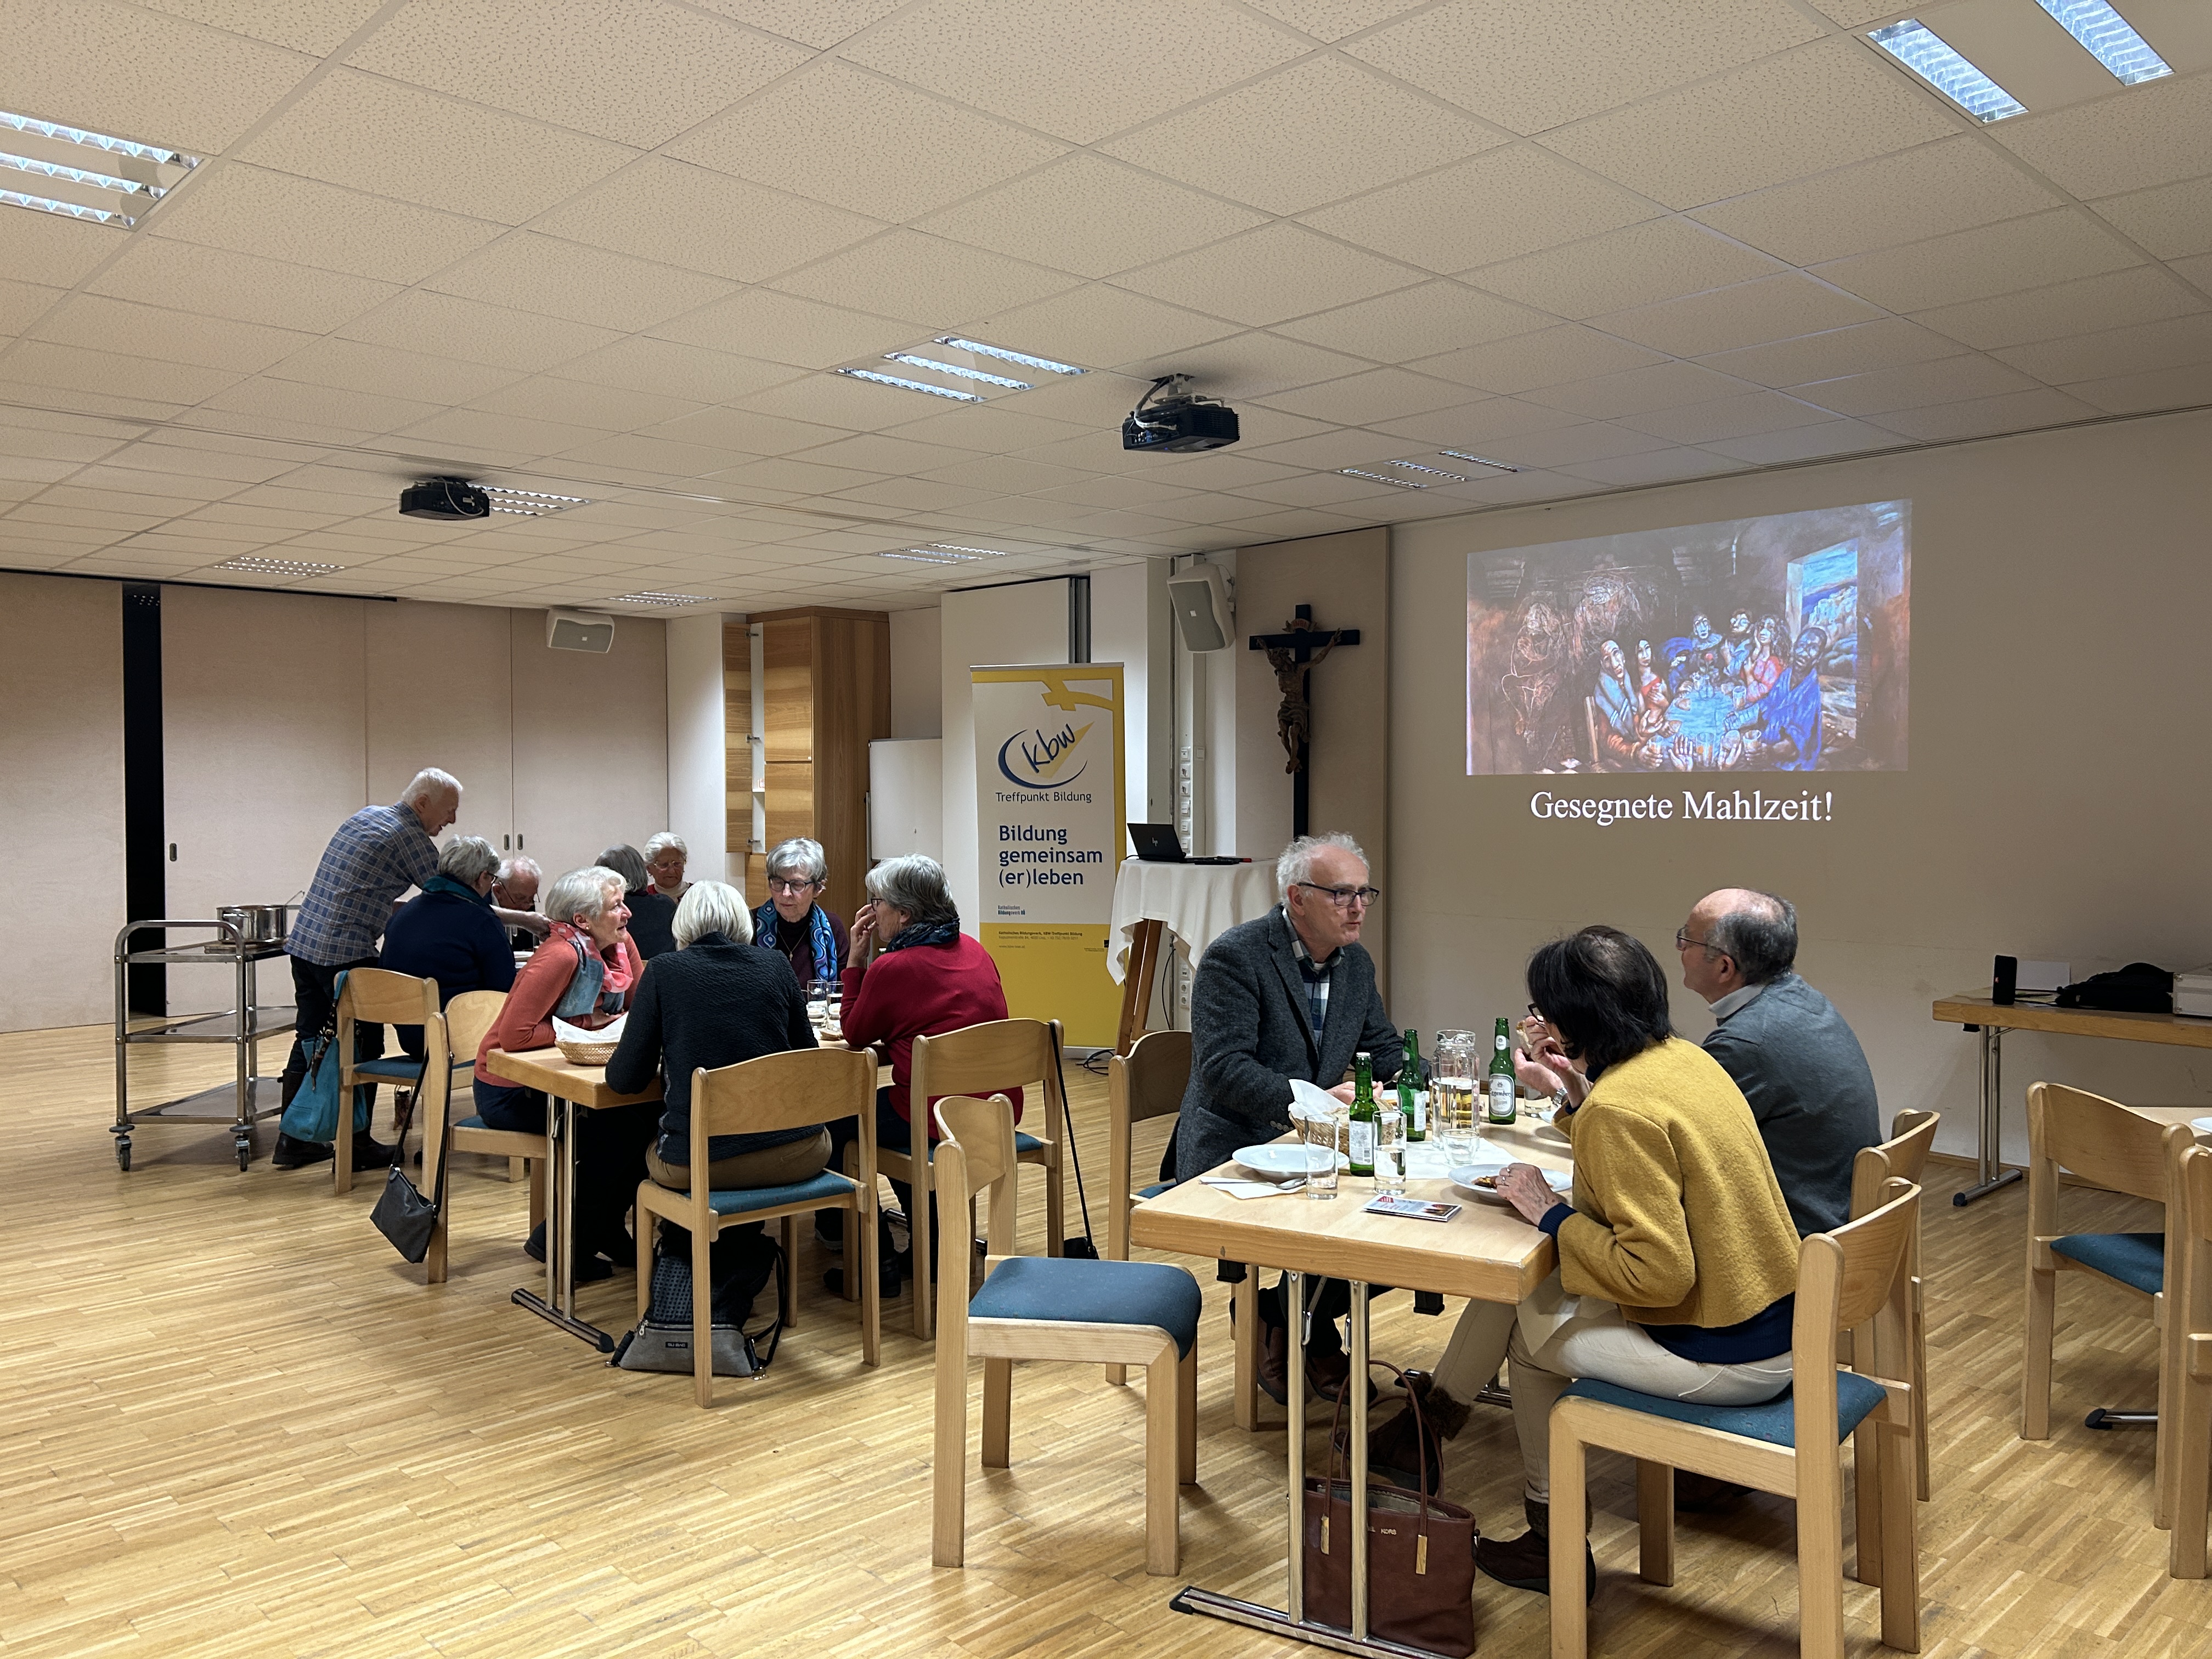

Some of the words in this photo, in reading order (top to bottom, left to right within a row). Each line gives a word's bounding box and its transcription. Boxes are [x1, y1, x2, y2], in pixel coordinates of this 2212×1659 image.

[995, 792, 1049, 804] Treffpunkt
[1053, 791, 1092, 804] Bildung
[1530, 791, 1673, 826] Gesegnete
[1681, 790, 1832, 821] Mahlzeit!
[999, 825, 1068, 845] Bildung
[999, 847, 1103, 867] gemeinsam
[999, 868, 1084, 889] (er)leben
